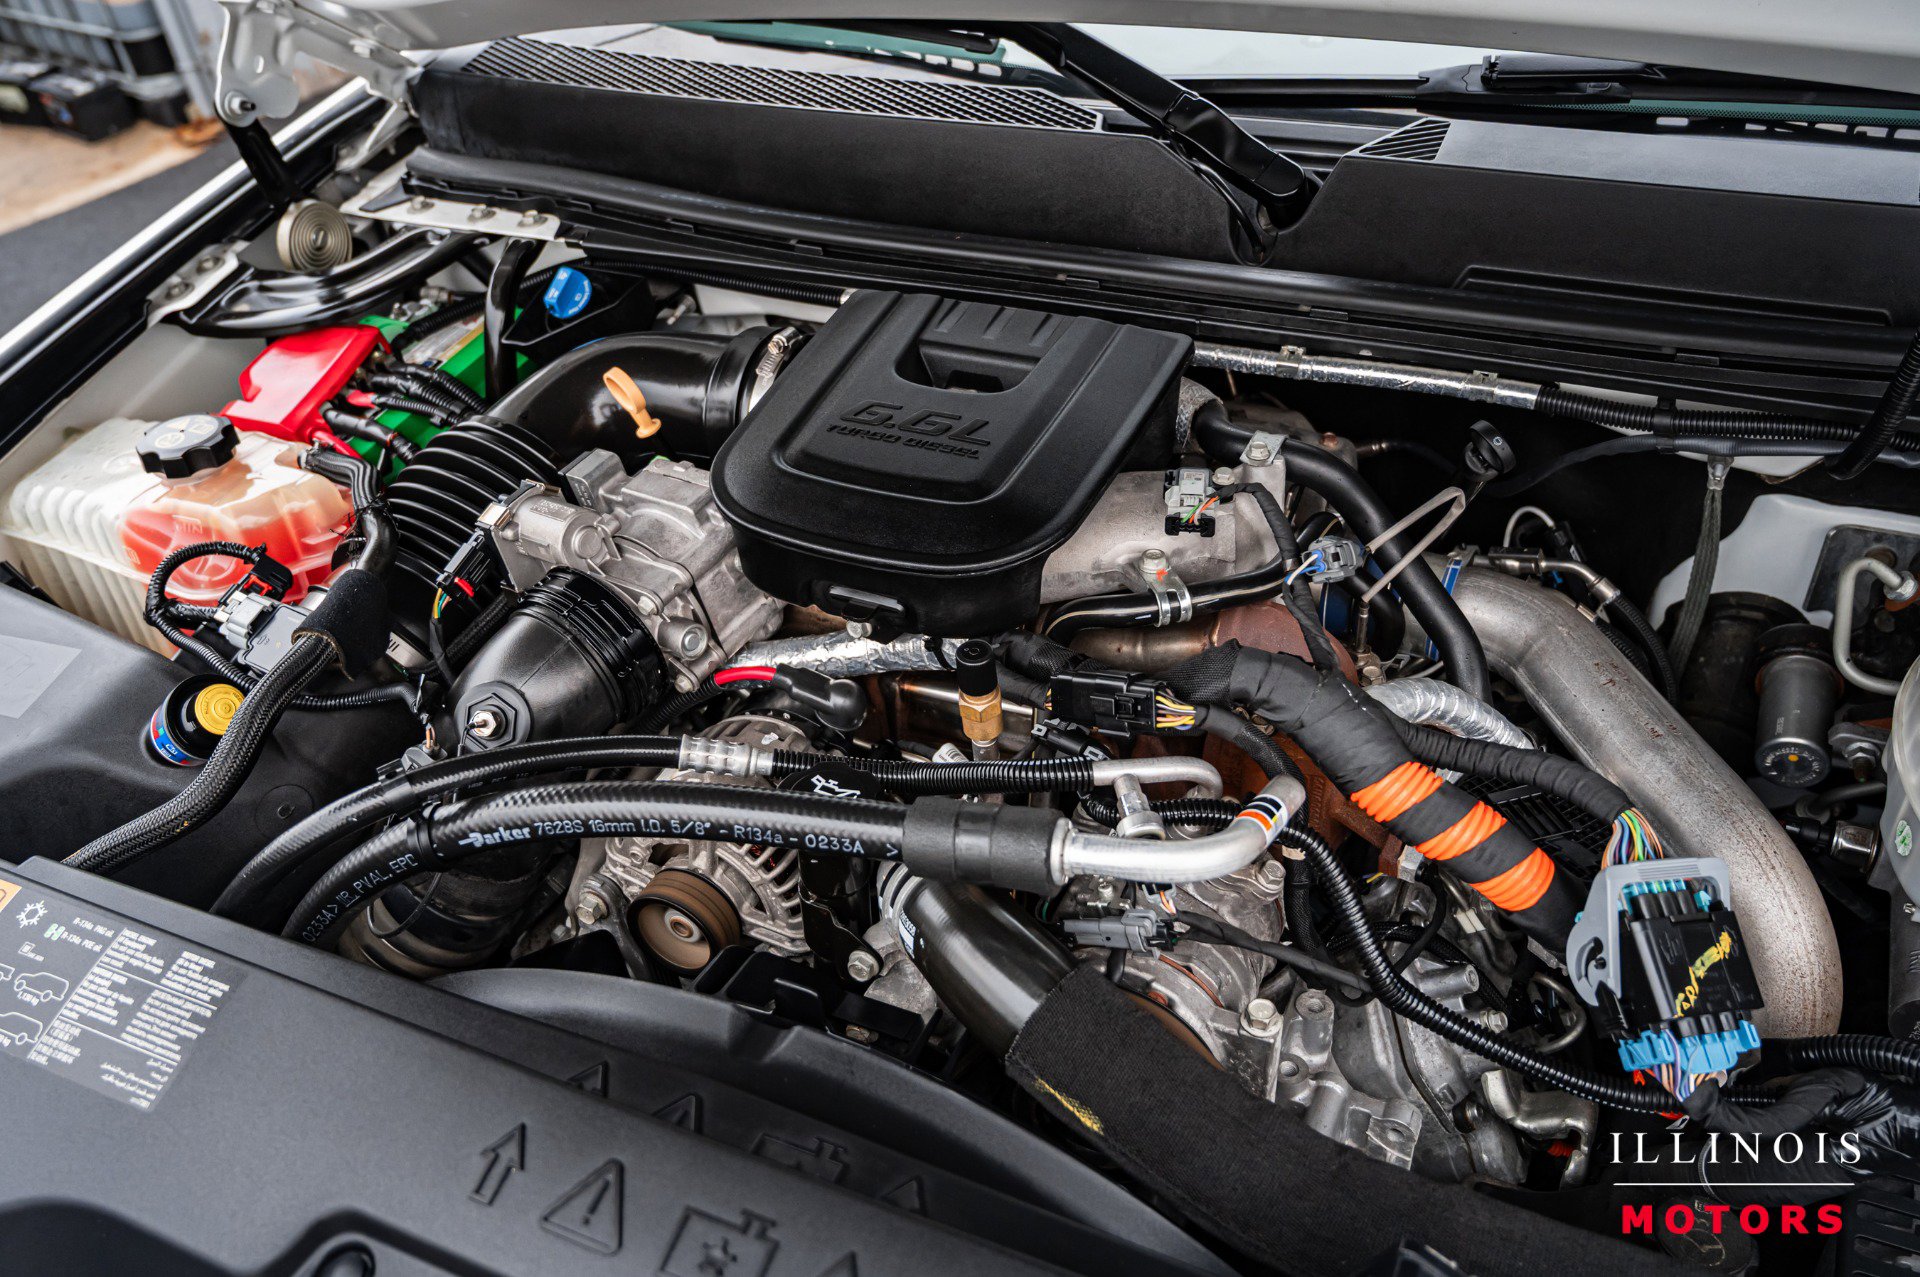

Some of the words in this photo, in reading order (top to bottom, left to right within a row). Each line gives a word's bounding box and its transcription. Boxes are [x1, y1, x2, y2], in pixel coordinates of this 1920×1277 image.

[840, 400, 991, 446] 6.6L
[826, 424, 901, 443] TURBO
[902, 437, 979, 459] DIESEL
[458, 826, 531, 848] Parker
[534, 819, 584, 836] 7628S
[588, 819, 637, 833] 16mm
[733, 824, 784, 844] R134a
[804, 833, 865, 855] 0233A
